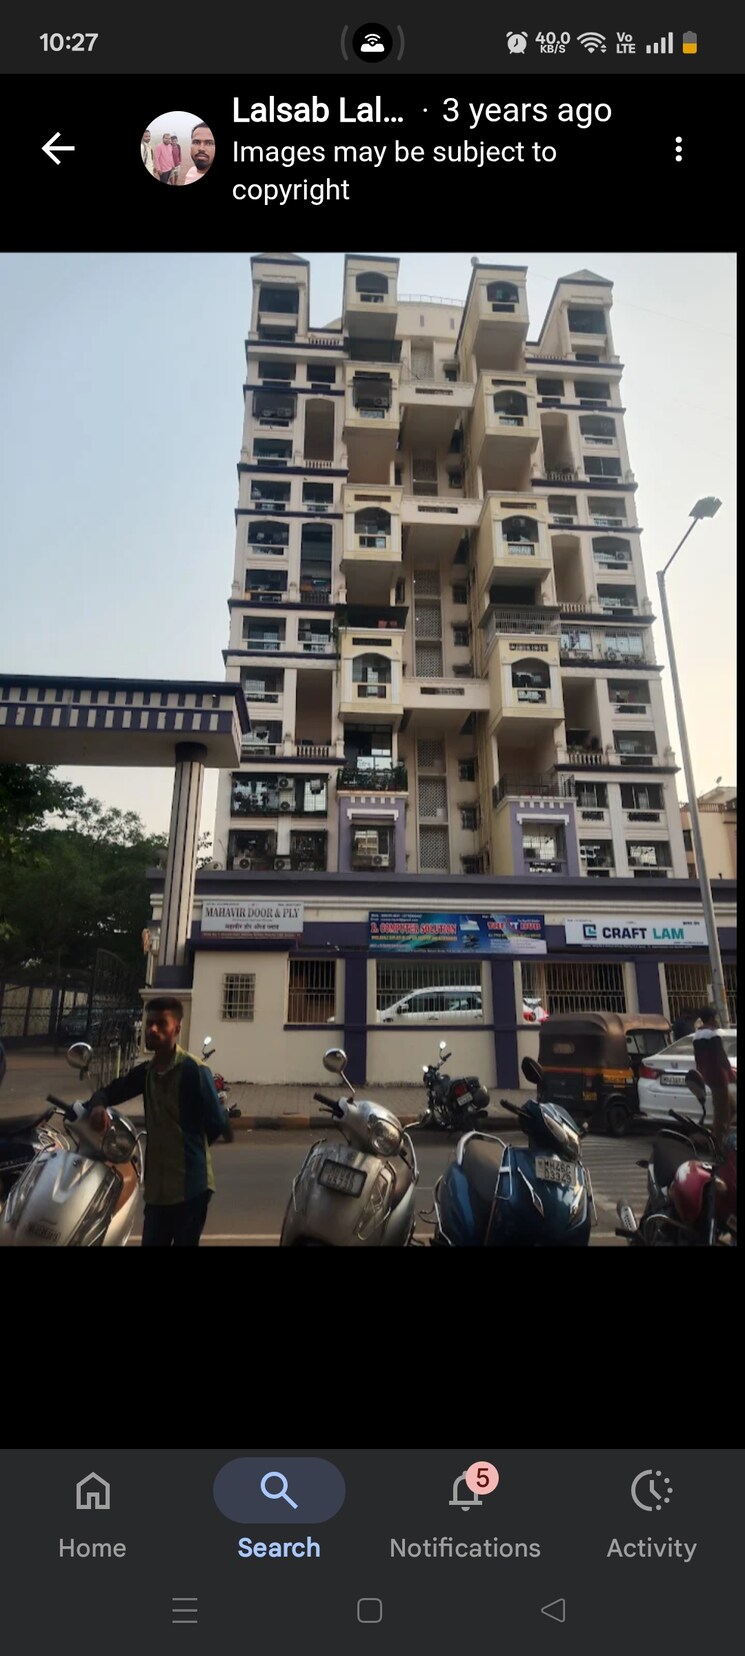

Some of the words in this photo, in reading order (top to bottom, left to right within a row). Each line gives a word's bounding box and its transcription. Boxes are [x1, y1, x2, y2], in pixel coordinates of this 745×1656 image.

[205, 907, 246, 917] MAHAVIR
[247, 907, 273, 918] DOOR
[274, 908, 281, 917] &
[282, 908, 300, 919] PLY
[380, 922, 419, 934] COMPUTER
[420, 923, 457, 934] SOLUTION
[602, 927, 647, 939] CRAFT
[653, 928, 685, 940] LAM
